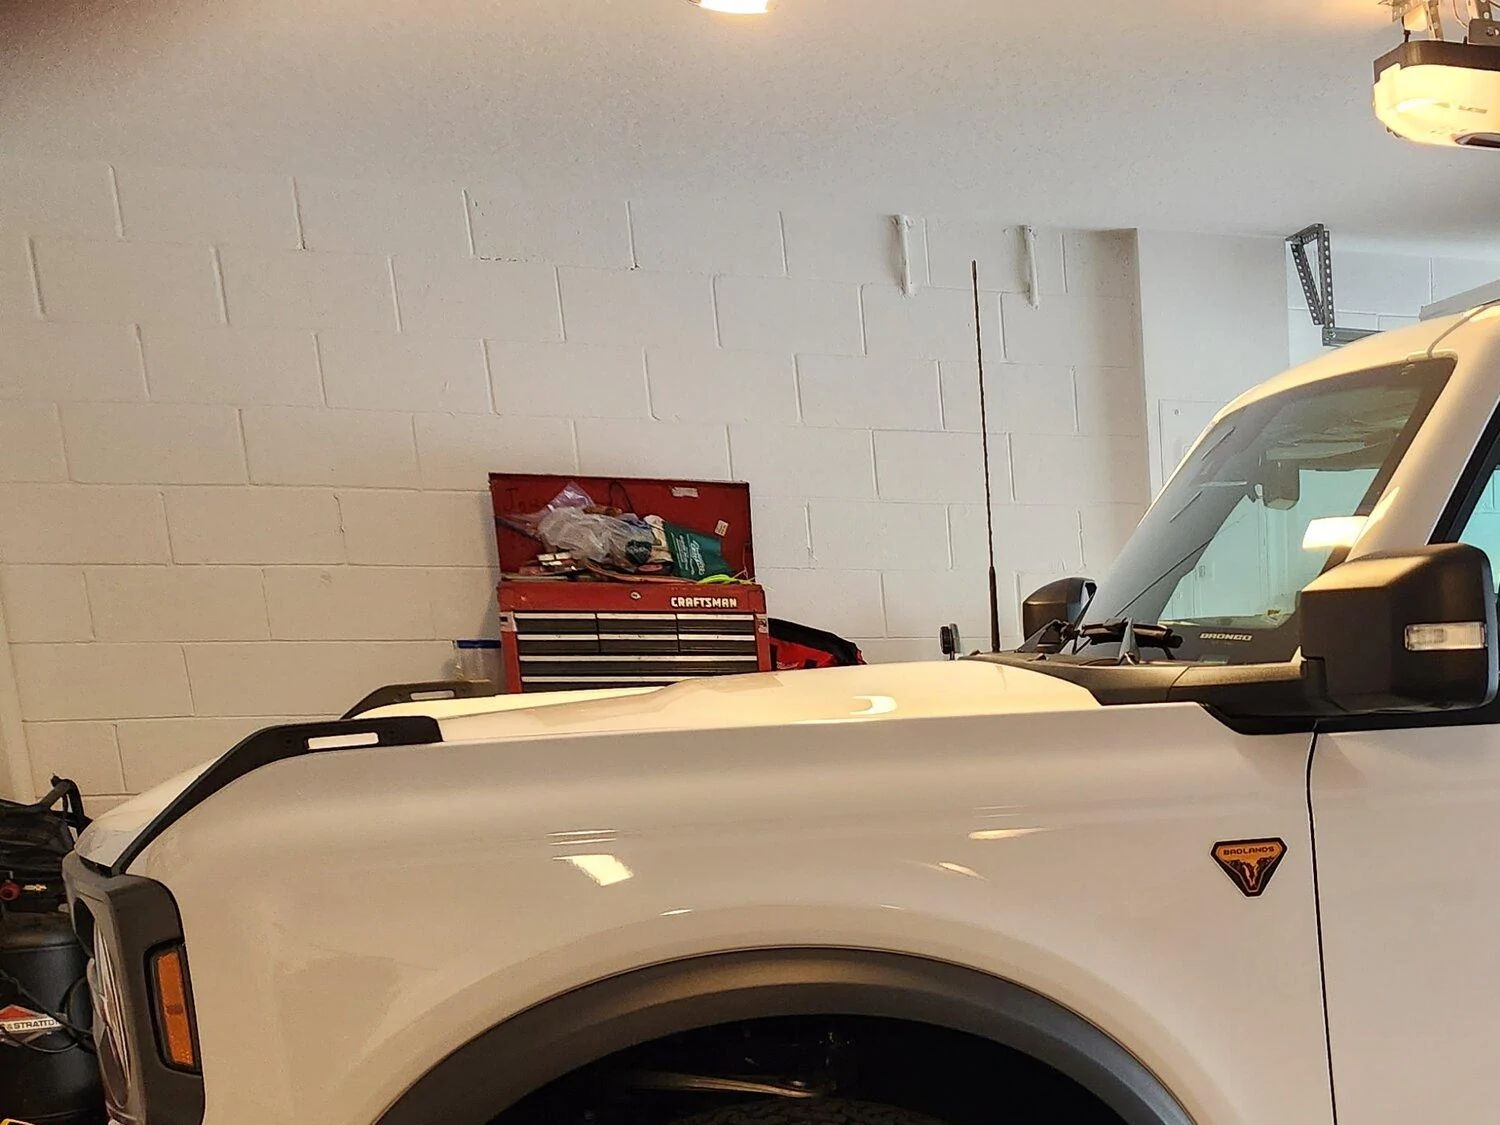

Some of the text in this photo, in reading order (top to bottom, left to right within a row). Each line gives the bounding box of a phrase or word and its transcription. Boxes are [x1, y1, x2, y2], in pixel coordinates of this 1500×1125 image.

[670, 596, 738, 608] CRAFTSMAN
[1199, 632, 1253, 642] BRONCO
[1223, 846, 1275, 856] BADLANDS
